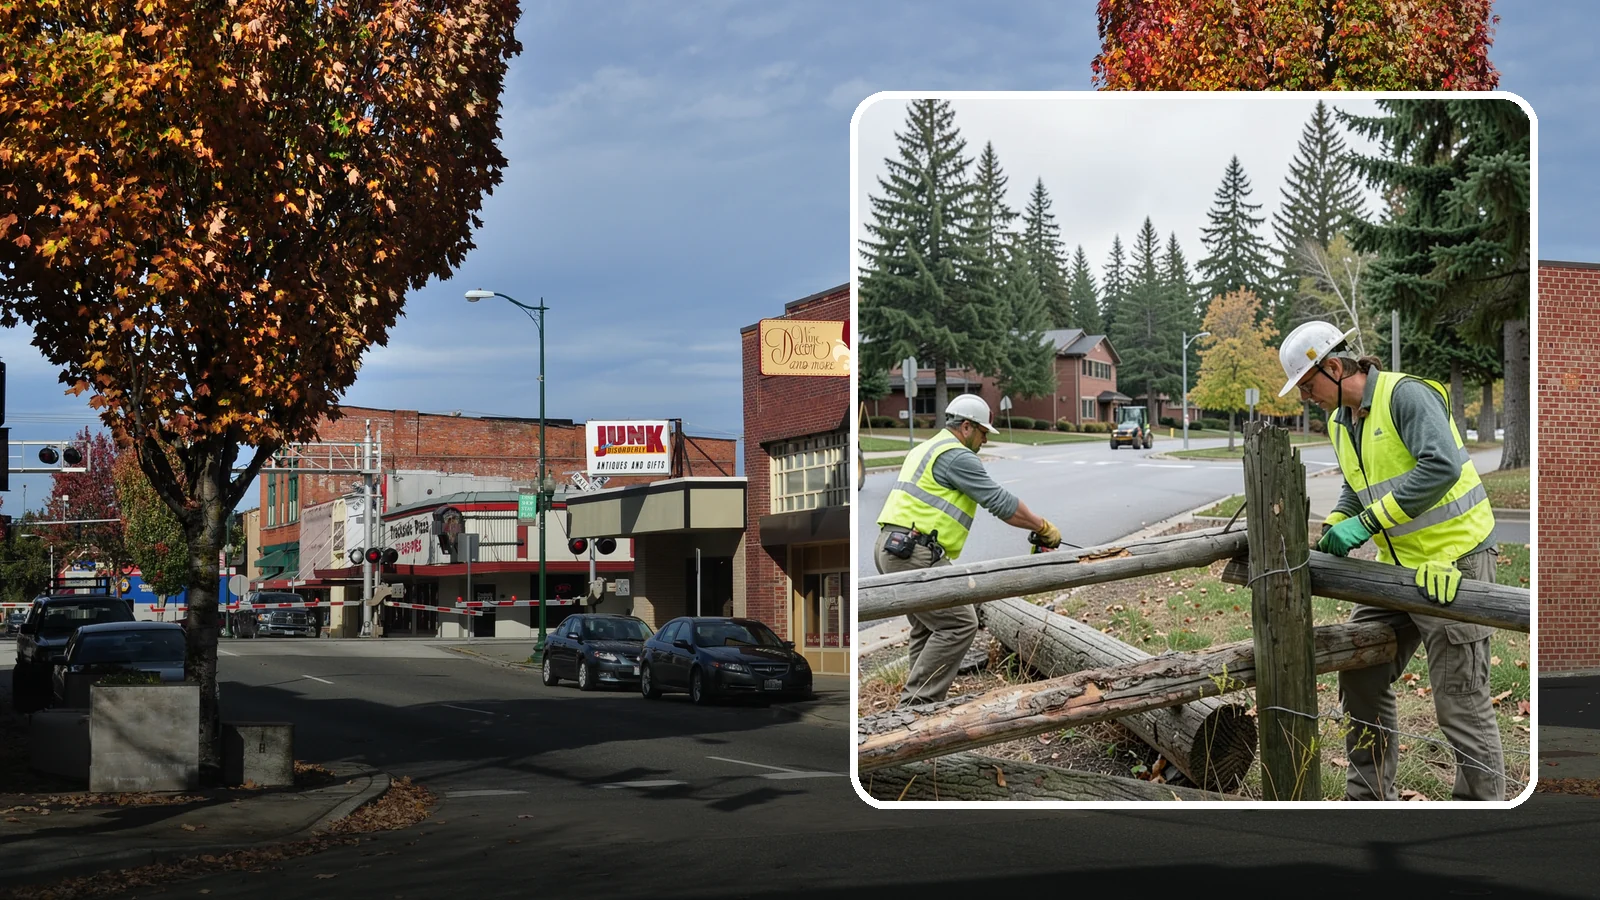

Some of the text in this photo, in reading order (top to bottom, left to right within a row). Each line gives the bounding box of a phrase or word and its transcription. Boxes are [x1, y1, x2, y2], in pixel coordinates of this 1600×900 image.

[596, 425, 664, 457] JUNK
[597, 460, 665, 470] ANTIQUES AND GIFTS
[390, 520, 429, 539] Trackside Pizza
